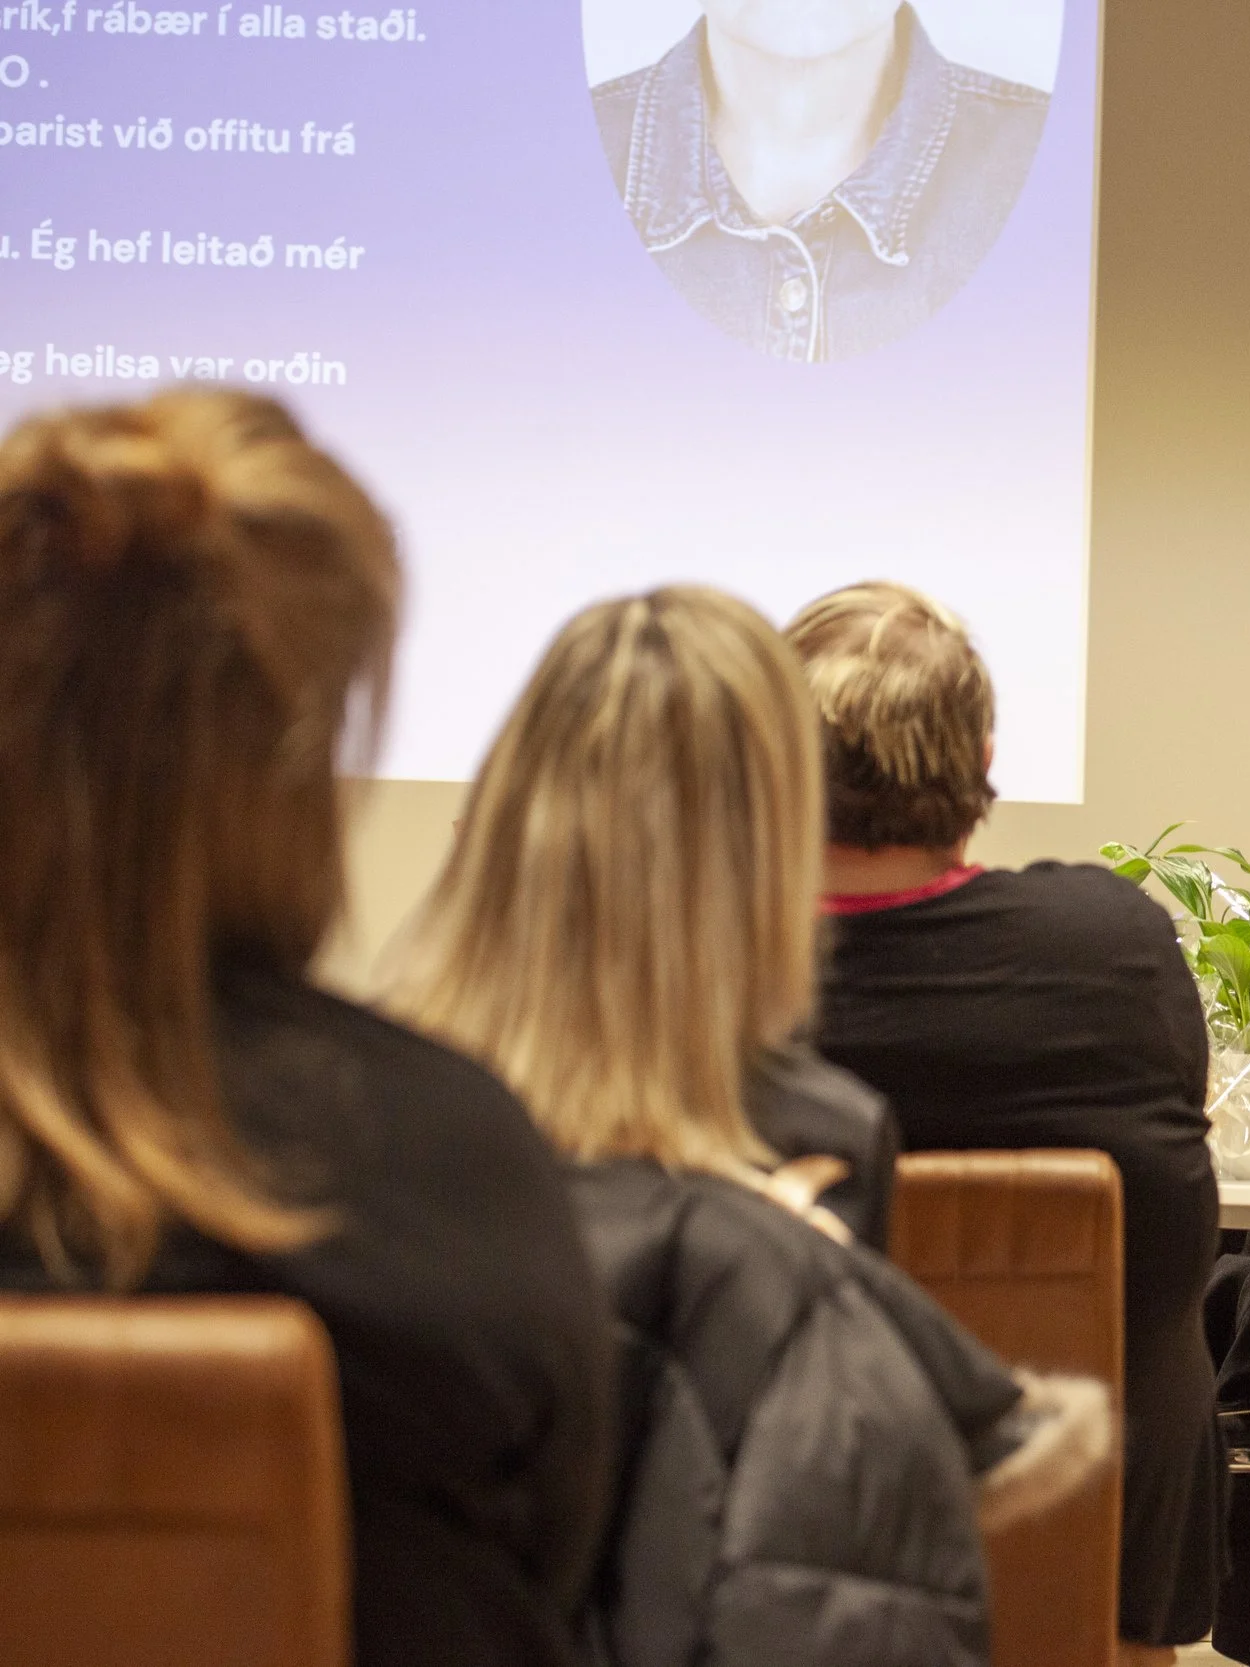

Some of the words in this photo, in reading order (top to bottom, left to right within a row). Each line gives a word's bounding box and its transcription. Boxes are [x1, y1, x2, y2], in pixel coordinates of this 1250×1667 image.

[86, 0, 208, 35] rábær
[218, 3, 232, 36] í
[239, 5, 305, 39] alla
[316, 8, 427, 42] staði.
[113, 116, 173, 150] við
[184, 118, 290, 153] offitu
[301, 121, 355, 155] frá
[31, 218, 77, 271] Ég
[88, 228, 152, 263] hef
[162, 231, 274, 267] leitað
[285, 236, 366, 270] mér
[45, 343, 160, 379] heilsa
[169, 355, 235, 380] var
[243, 351, 347, 386] orðin
